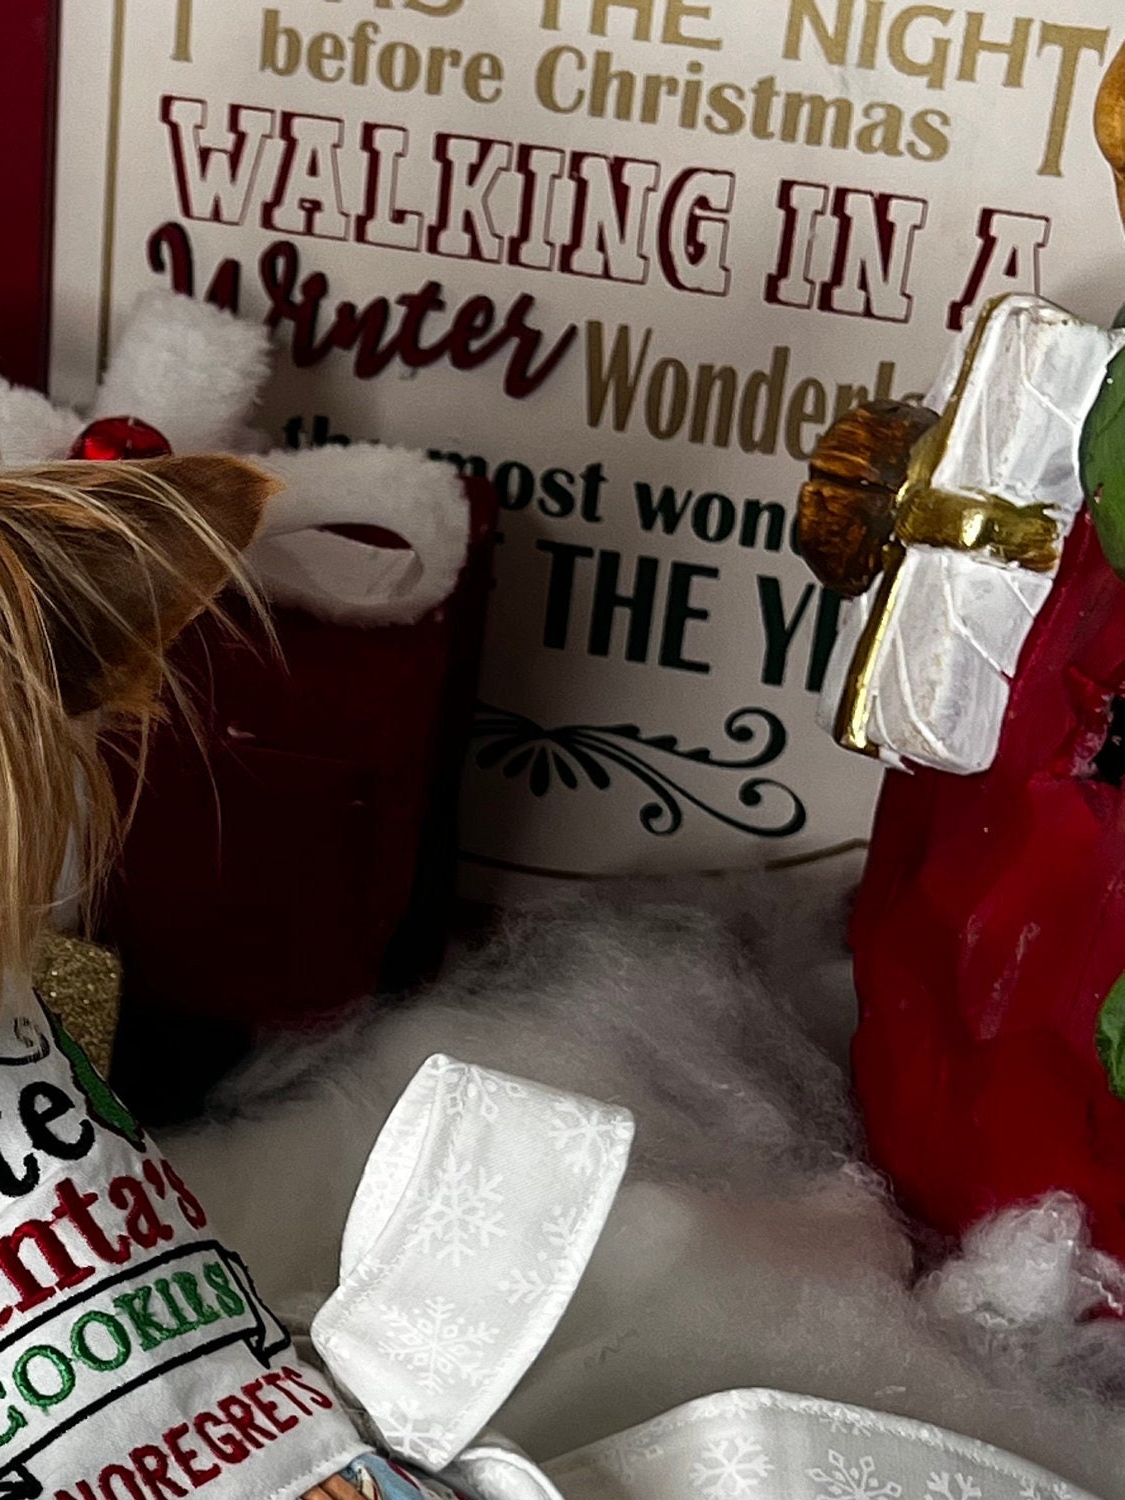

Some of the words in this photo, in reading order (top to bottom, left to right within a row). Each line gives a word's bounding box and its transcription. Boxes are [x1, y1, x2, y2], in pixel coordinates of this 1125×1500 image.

[259, 8, 505, 103] before
[535, 45, 951, 161] Christmas
[782, 0, 1111, 178] NIGHT
[160, 94, 736, 296] WALKING
[764, 179, 928, 324] IN
[946, 207, 1051, 332] A
[634, 481, 810, 557] won
[536, 539, 720, 675] THE
